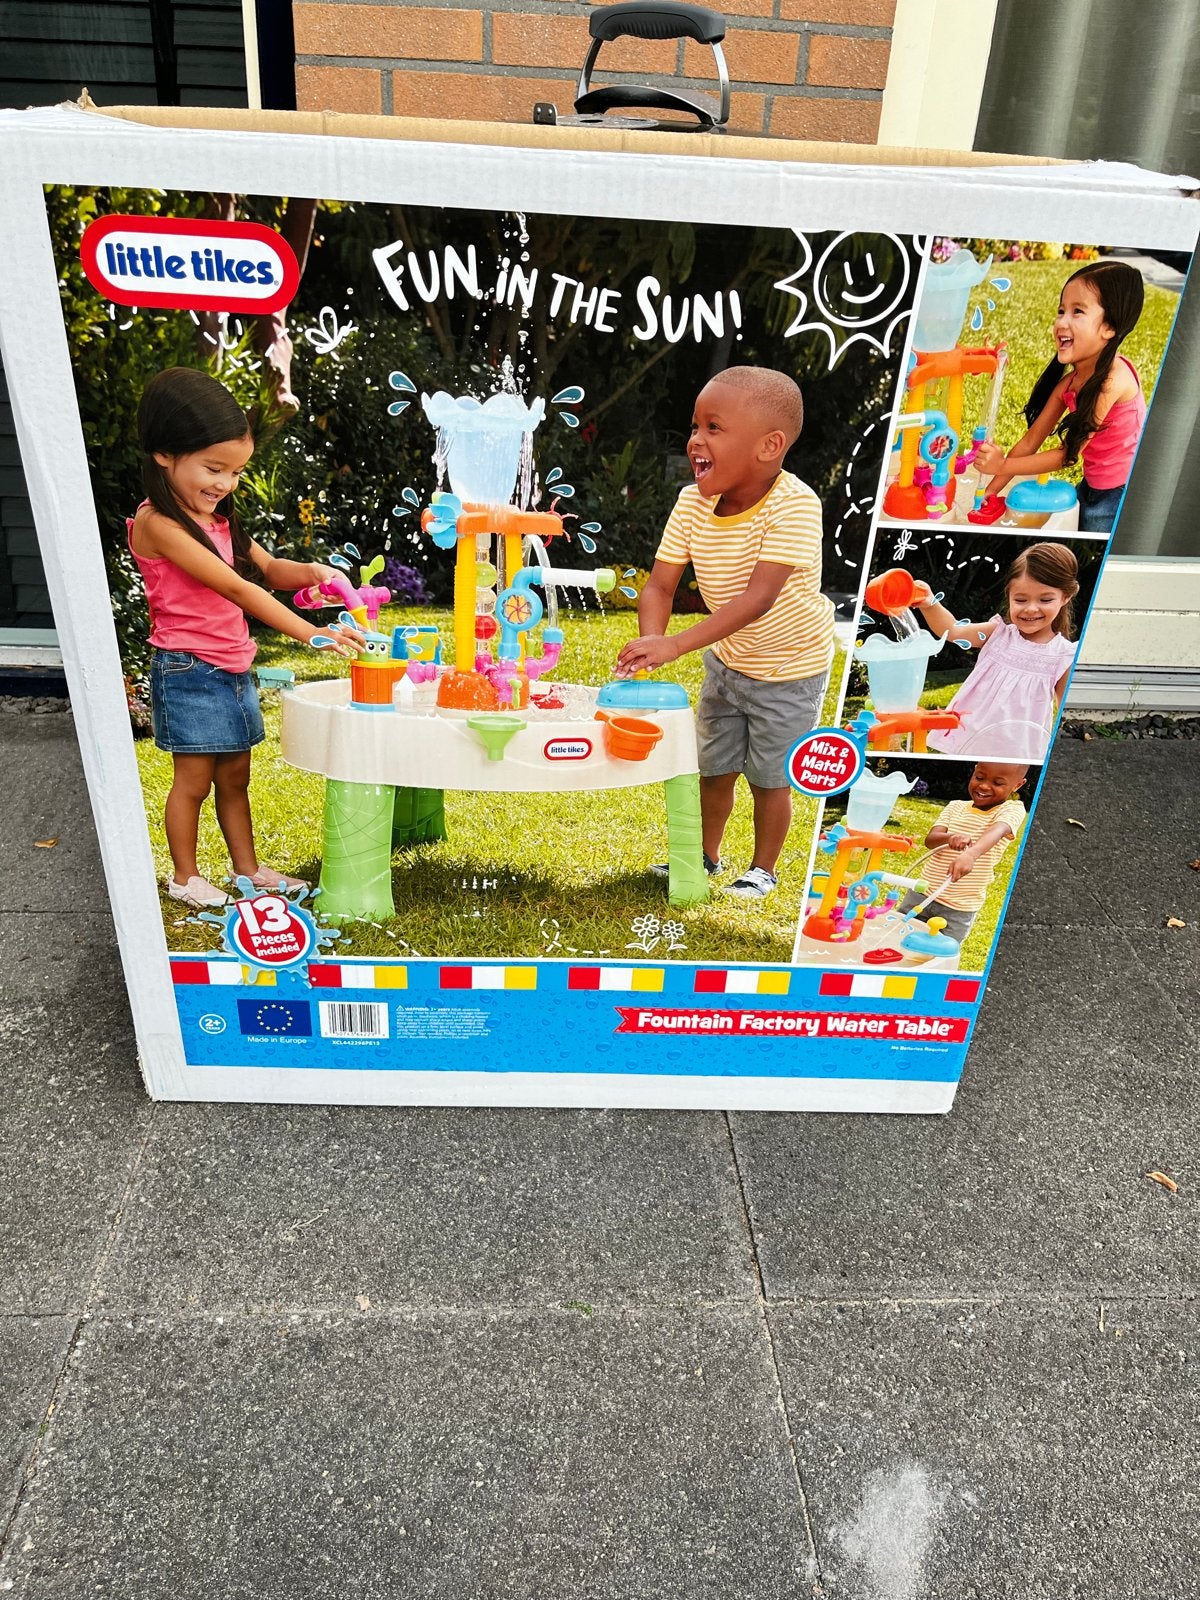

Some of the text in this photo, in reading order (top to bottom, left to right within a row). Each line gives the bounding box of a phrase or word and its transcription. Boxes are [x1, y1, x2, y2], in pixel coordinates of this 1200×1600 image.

[105, 242, 274, 285] little tikes
[372, 240, 478, 311] FUN
[550, 272, 622, 334] THE
[632, 276, 743, 343] SUN!
[551, 746, 567, 754] little
[809, 740, 849, 758] Mix &
[801, 755, 846, 774] Match
[800, 770, 837, 787] Parts
[238, 895, 291, 935] 13
[251, 933, 296, 947] Pieces
[256, 942, 300, 957] Included
[205, 1018, 221, 1027] 2+
[638, 1012, 733, 1030] Fountain
[739, 1014, 820, 1037] Factory
[826, 1015, 889, 1033] Water
